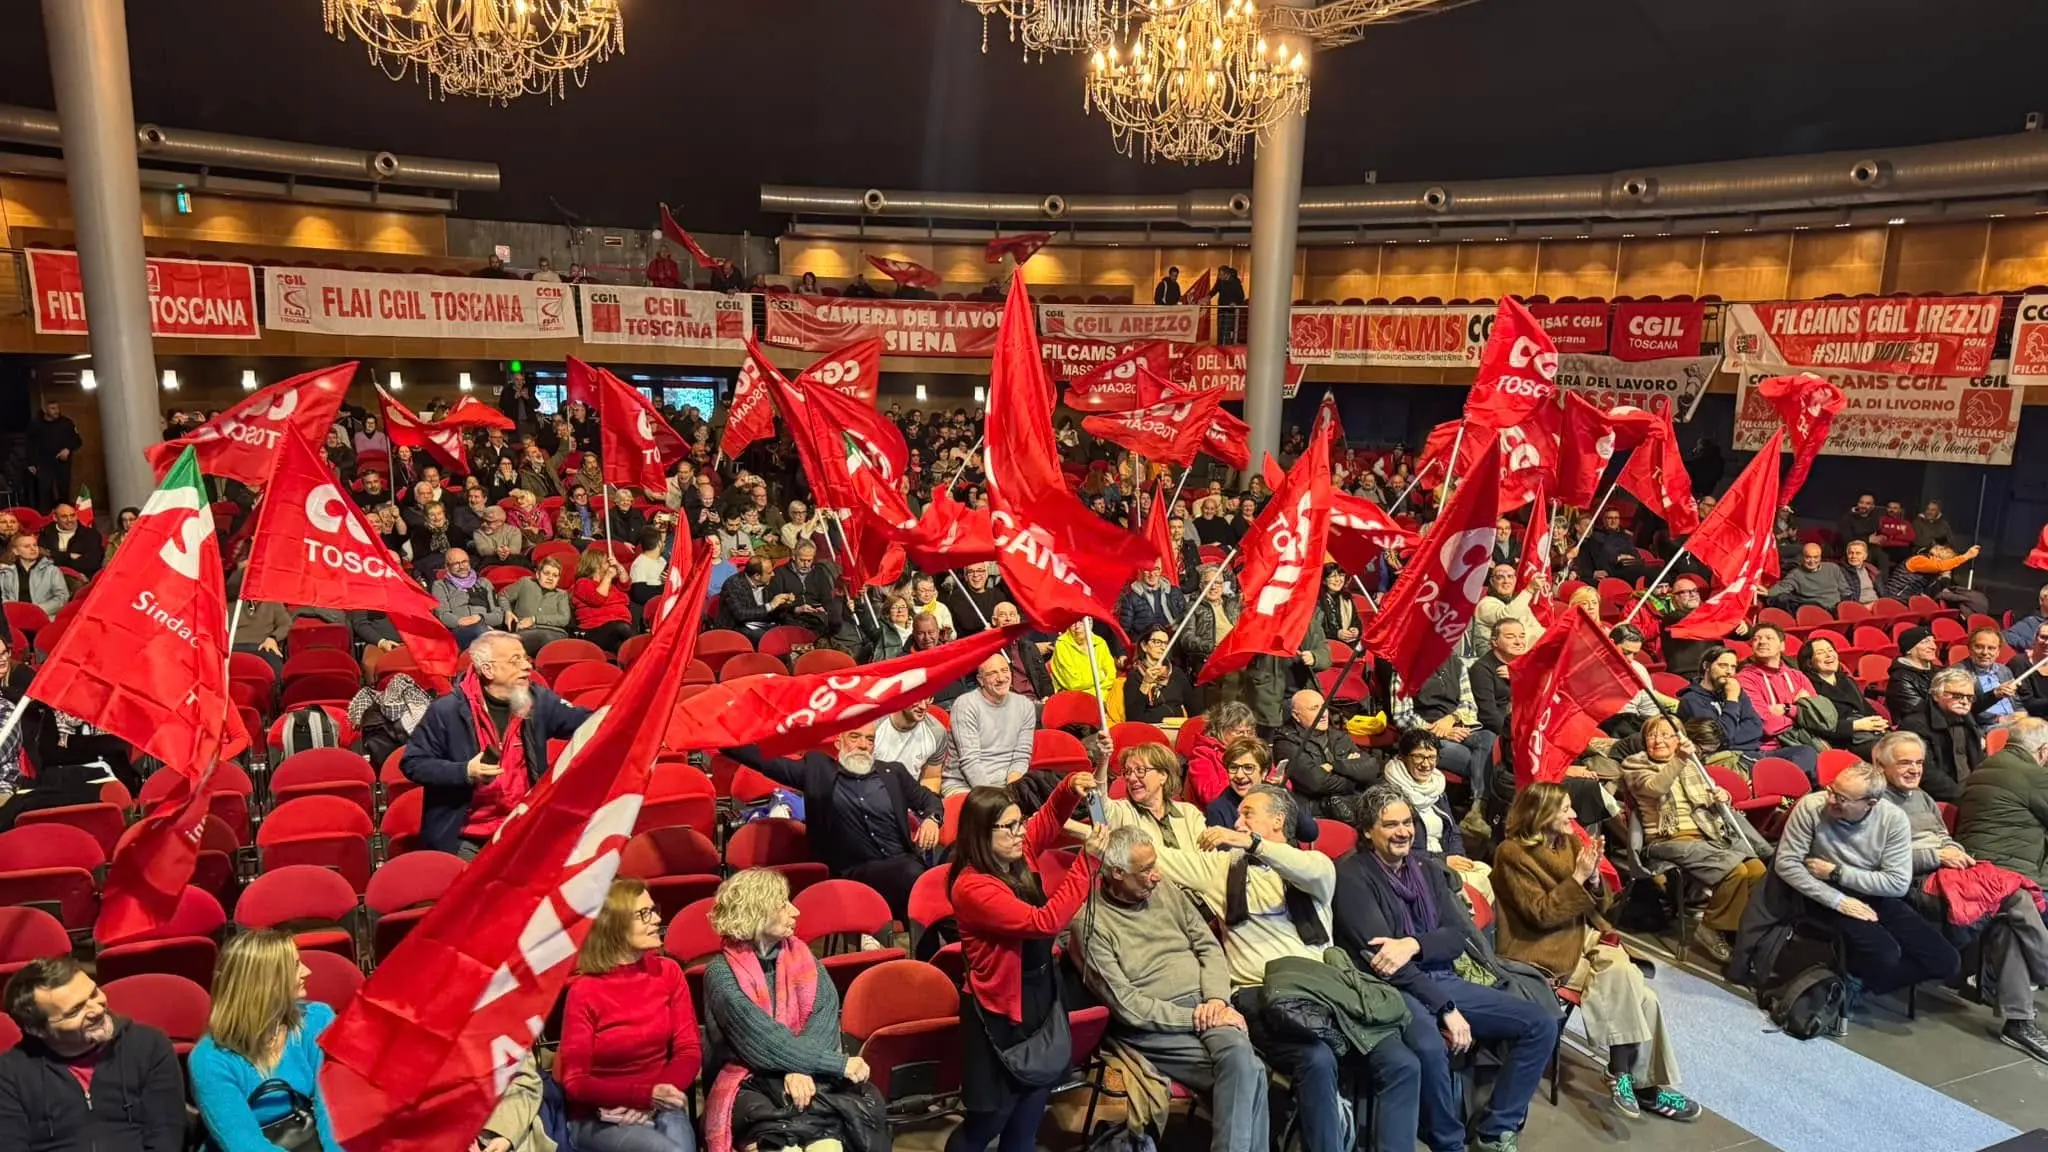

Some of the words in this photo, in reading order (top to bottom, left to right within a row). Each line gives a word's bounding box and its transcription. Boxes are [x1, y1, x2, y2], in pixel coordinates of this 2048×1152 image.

[536, 287, 563, 298] CGIL
[591, 293, 620, 304] CGIL
[148, 295, 249, 327] TOSCANA
[322, 286, 372, 319] FLAI
[378, 289, 426, 321] CGIL
[430, 291, 524, 324] TOSCANA
[644, 296, 693, 318] CGIL
[715, 299, 744, 311] CGIL
[815, 305, 898, 326] CAMERA
[902, 309, 940, 328] DEL
[1045, 310, 1065, 318] CGIL
[1572, 315, 1603, 328] CGIL
[1770, 306, 1860, 335] FILCAMS
[1865, 305, 1911, 334] CGIL
[1914, 302, 1997, 334] AREZZO
[625, 318, 714, 339] TOSCANA
[1072, 315, 1113, 334] CGIL
[1118, 314, 1192, 333] AREZZO
[1628, 315, 1684, 337] CGIL
[771, 335, 800, 345] SIENA
[1337, 314, 1464, 352] FILCAMS
[884, 331, 957, 352] SIENA
[1629, 338, 1679, 351] TOSCANA
[1963, 337, 1987, 347] CGIL
[1041, 343, 1117, 361] FILCAMS
[1196, 354, 1222, 370] DEL
[1585, 376, 1612, 388] DEL
[1616, 378, 1678, 391] LAVORO
[1895, 375, 1948, 391] CGIL
[1969, 377, 2010, 388] CGIL
[1866, 398, 1883, 409] DI
[1886, 399, 1956, 411] LIVORNO
